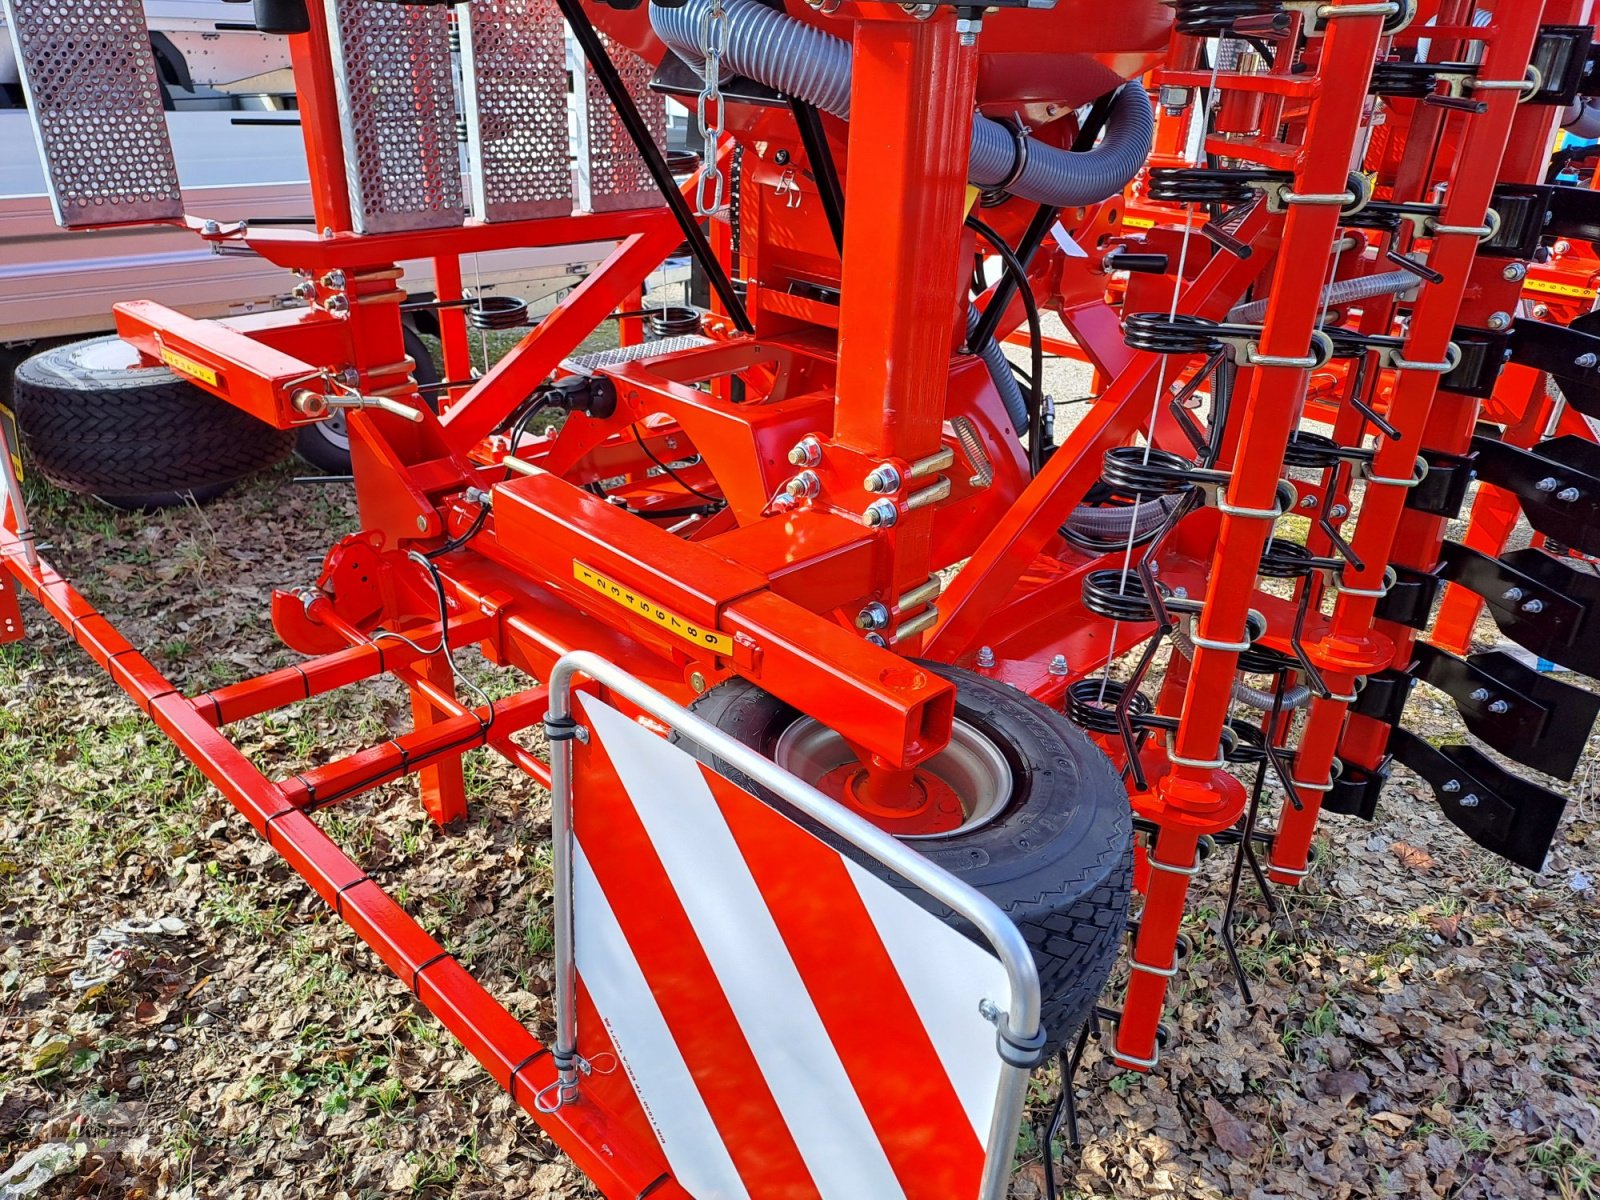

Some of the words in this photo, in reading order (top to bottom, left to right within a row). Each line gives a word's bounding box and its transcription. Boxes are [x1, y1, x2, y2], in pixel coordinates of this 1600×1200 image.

[597, 579, 606, 589] 2
[611, 586, 620, 596] 3
[625, 594, 635, 604] 4
[640, 602, 650, 612] 5
[655, 610, 665, 620] 6
[671, 617, 681, 628] 7
[687, 626, 698, 637] 8
[704, 634, 718, 644] 9
